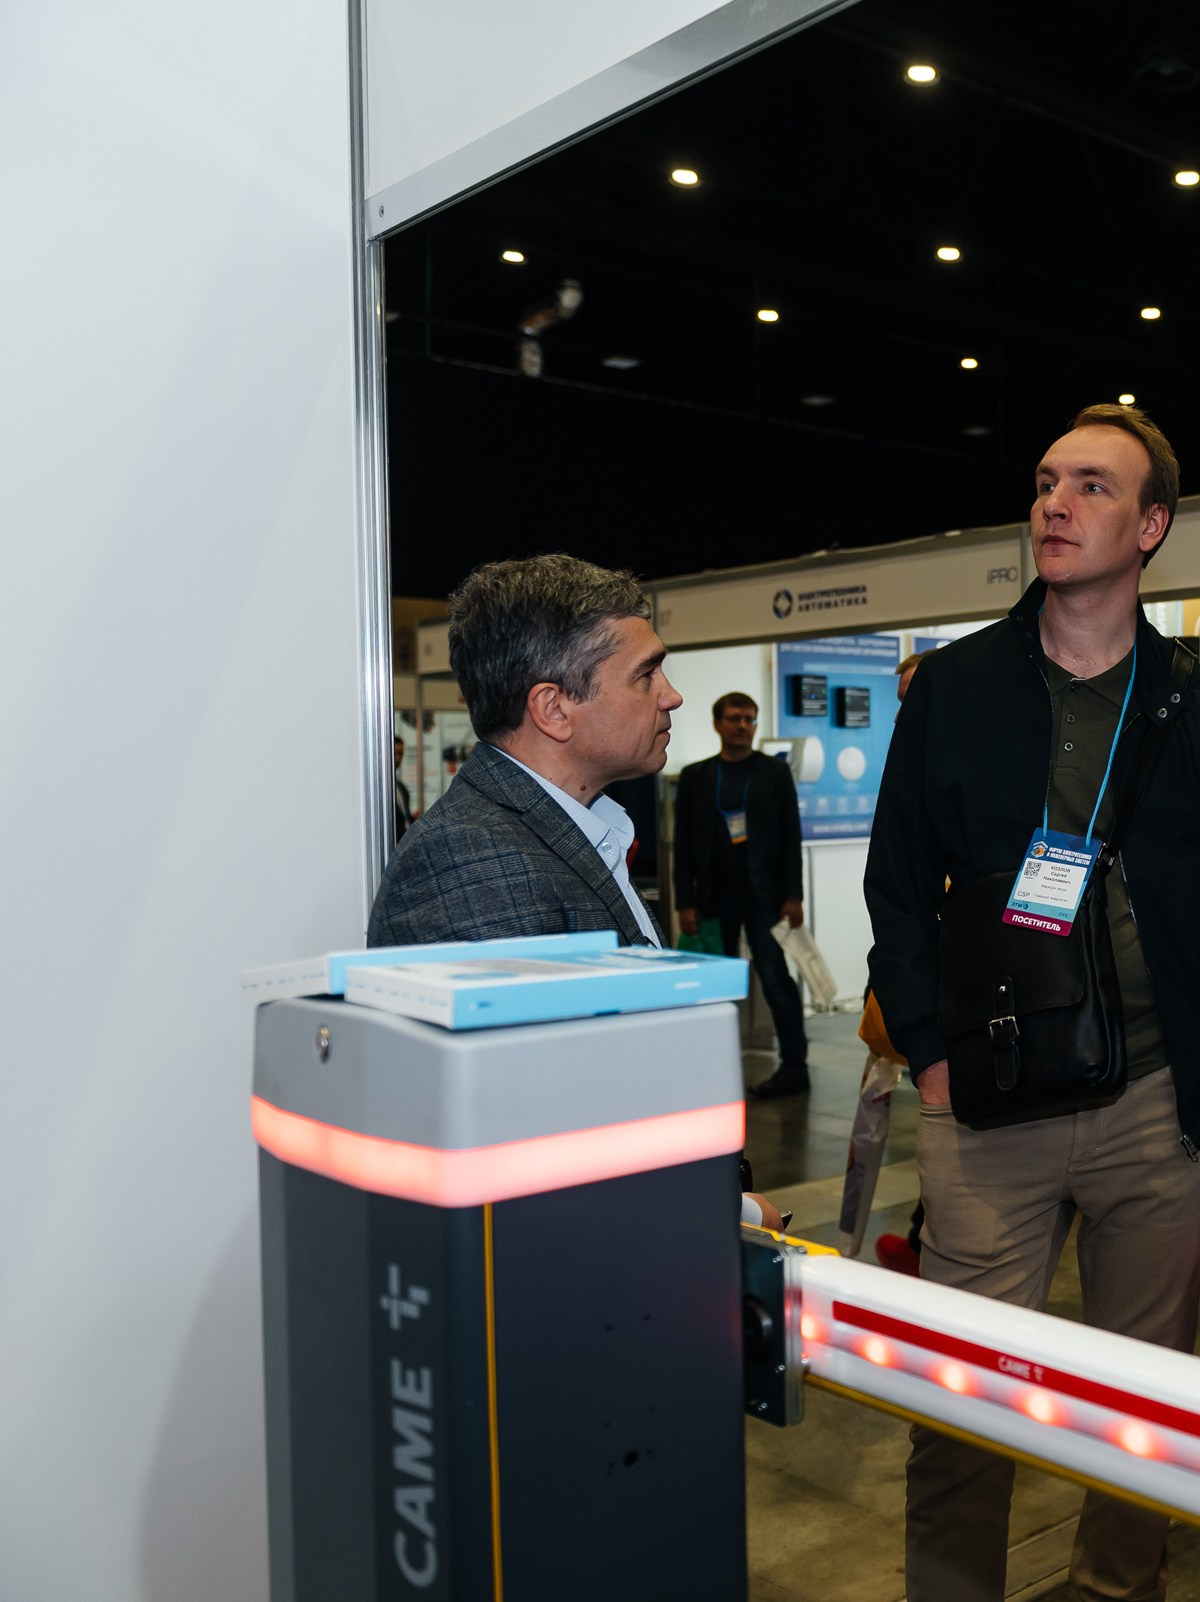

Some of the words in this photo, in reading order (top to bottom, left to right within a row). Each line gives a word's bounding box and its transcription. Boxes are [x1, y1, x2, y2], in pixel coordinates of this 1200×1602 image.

[1017, 890, 1031, 898] CSP
[1012, 914, 1061, 932] ПОСЕТИТЕЛЬ
[393, 1358, 439, 1588] CAME
